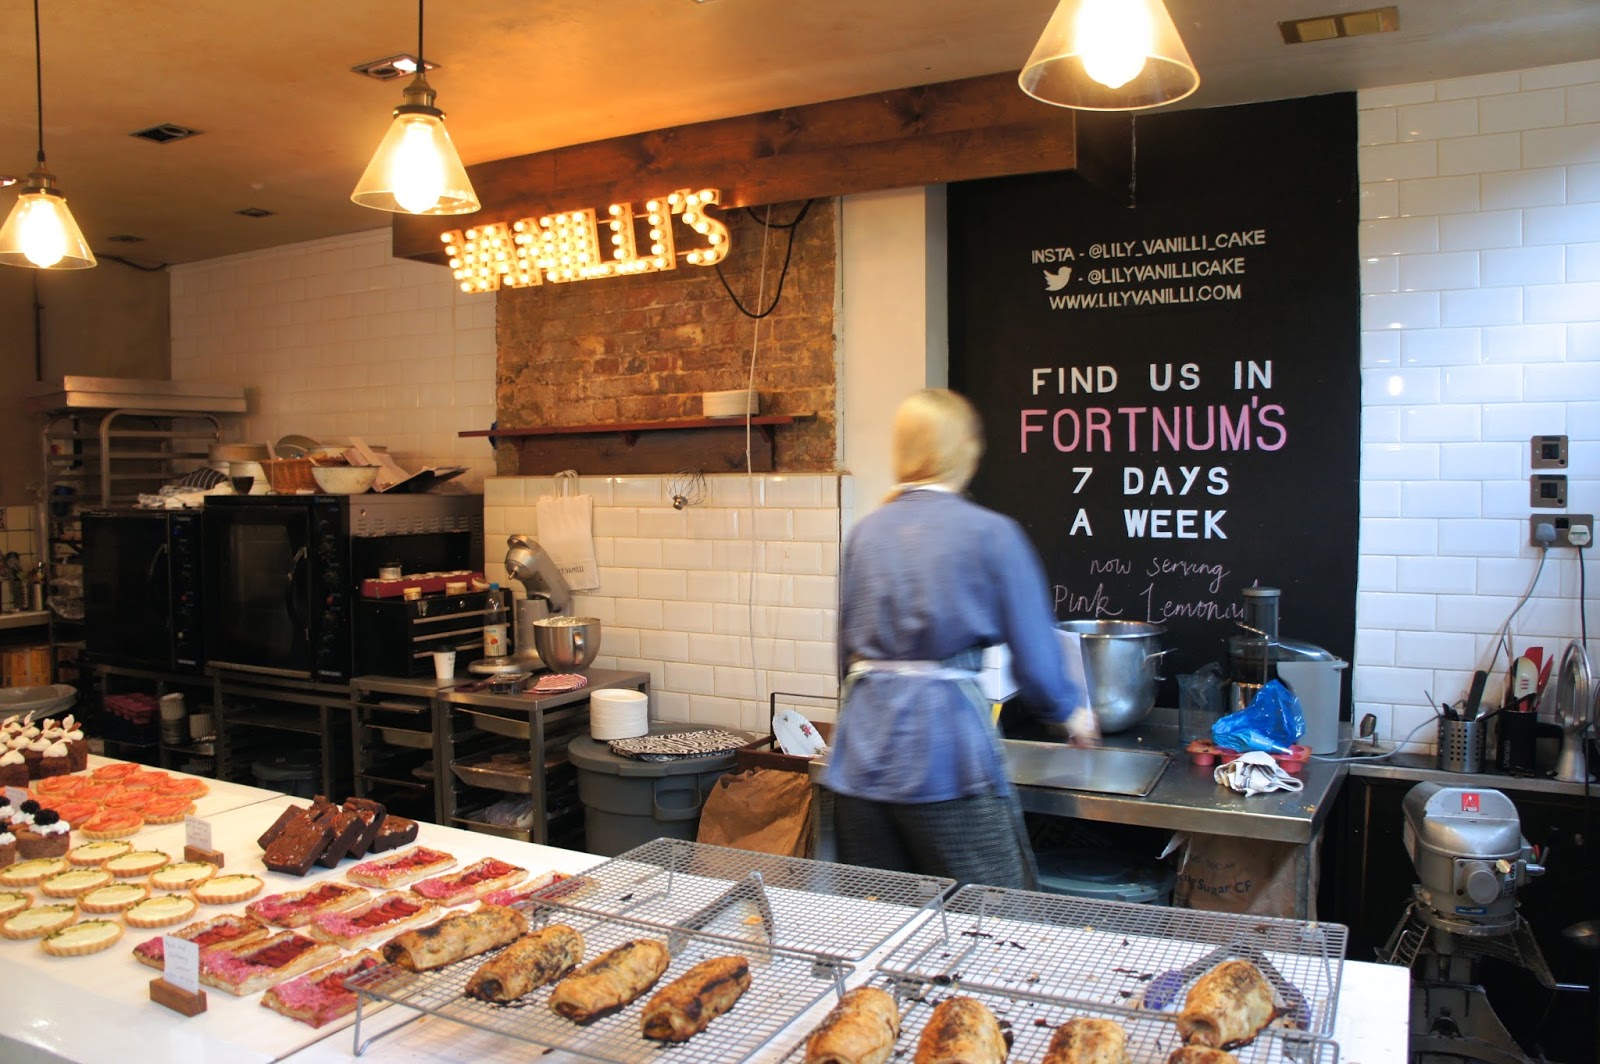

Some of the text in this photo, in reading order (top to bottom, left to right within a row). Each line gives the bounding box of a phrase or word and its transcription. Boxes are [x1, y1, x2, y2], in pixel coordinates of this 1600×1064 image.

[1031, 247, 1075, 264] INSTA
[1088, 230, 1266, 259] @LILY_VANILLI_CAKE
[1087, 257, 1246, 285] @LILYVANILLICAKE
[1049, 284, 1242, 310] WWW.LILYVANILLI.COM
[1032, 360, 1272, 395] FIND US IN
[1020, 396, 1287, 453] FORTNUM'S
[1072, 467, 1229, 495] 7 DAYS
[1069, 508, 1228, 539] A WEEK
[1090, 557, 1132, 575] now
[1053, 583, 1123, 617] Pink
[1197, 879, 1231, 896] Sugar
[1234, 880, 1252, 893] CF
